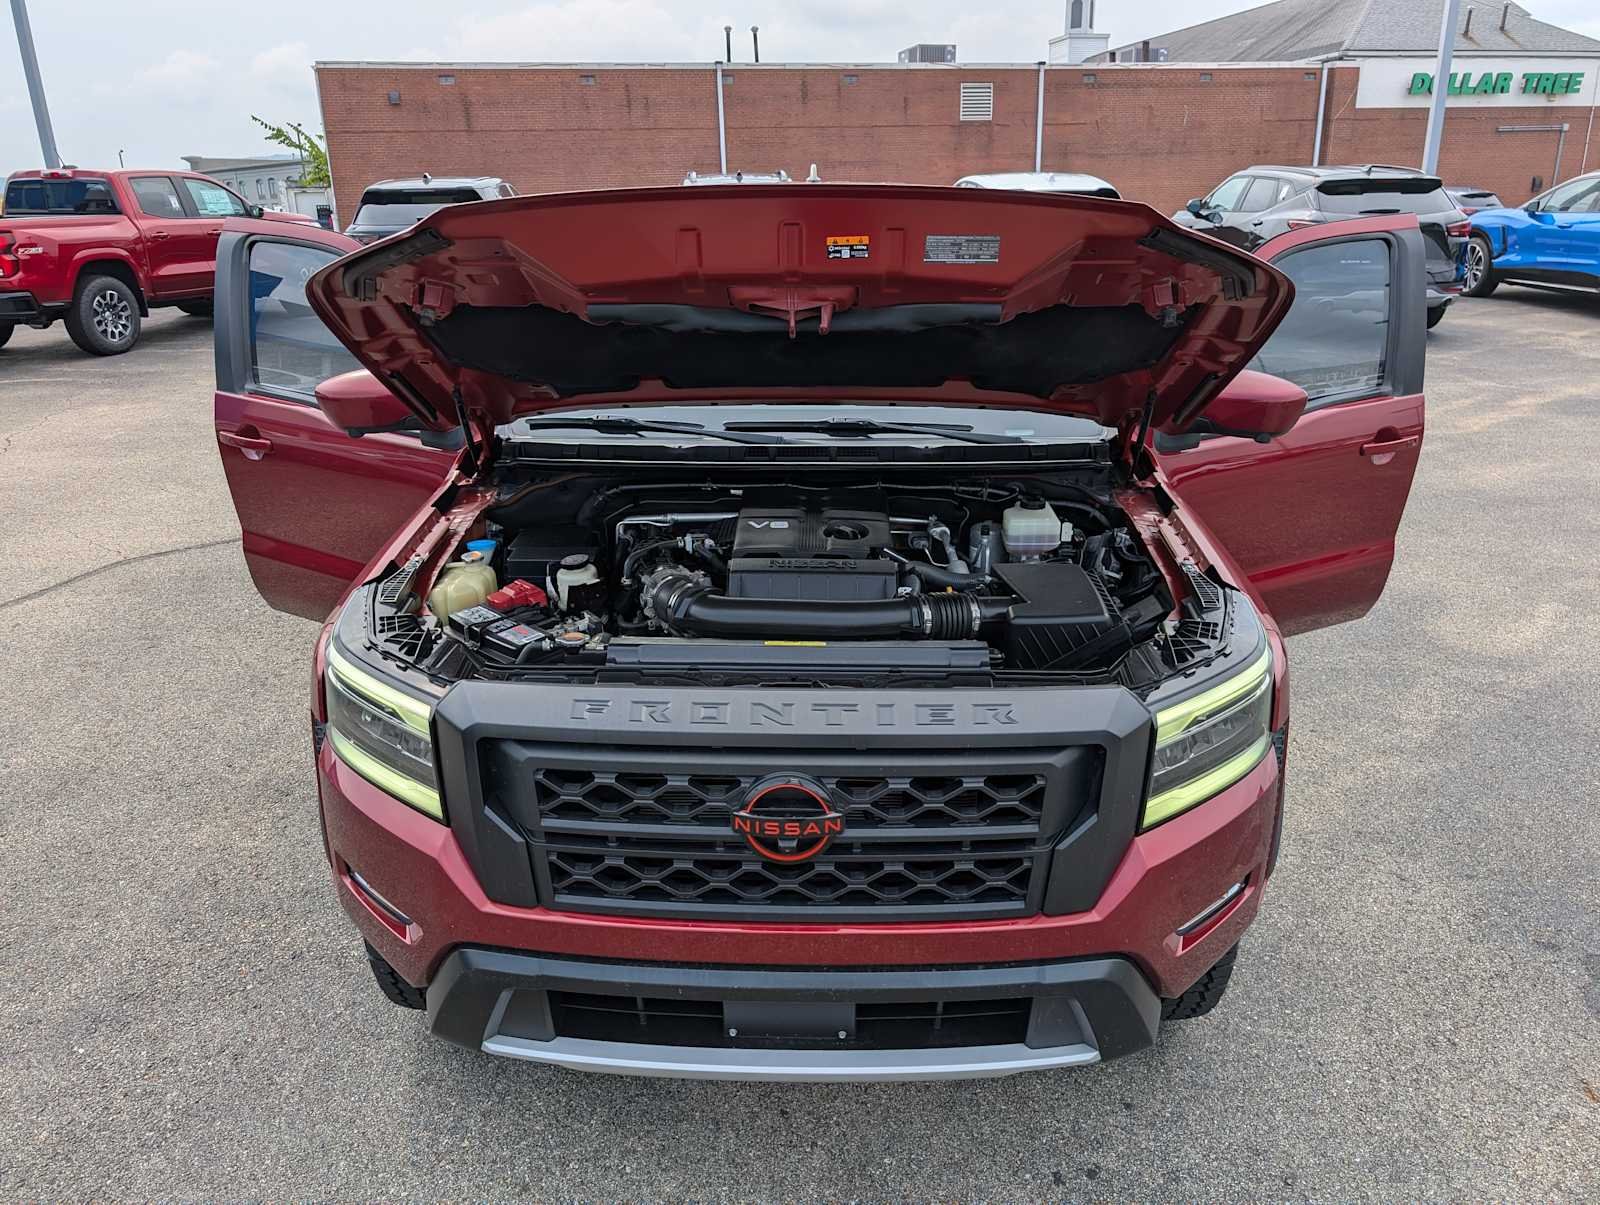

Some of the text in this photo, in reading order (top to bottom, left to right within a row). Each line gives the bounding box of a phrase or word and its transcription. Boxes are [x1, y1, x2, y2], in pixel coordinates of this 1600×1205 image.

[1408, 72, 1585, 95] DLLAR TREE
[768, 559, 857, 569] NISSAN
[570, 699, 1019, 726] FRONTIER
[734, 815, 841, 836] NISSAN
